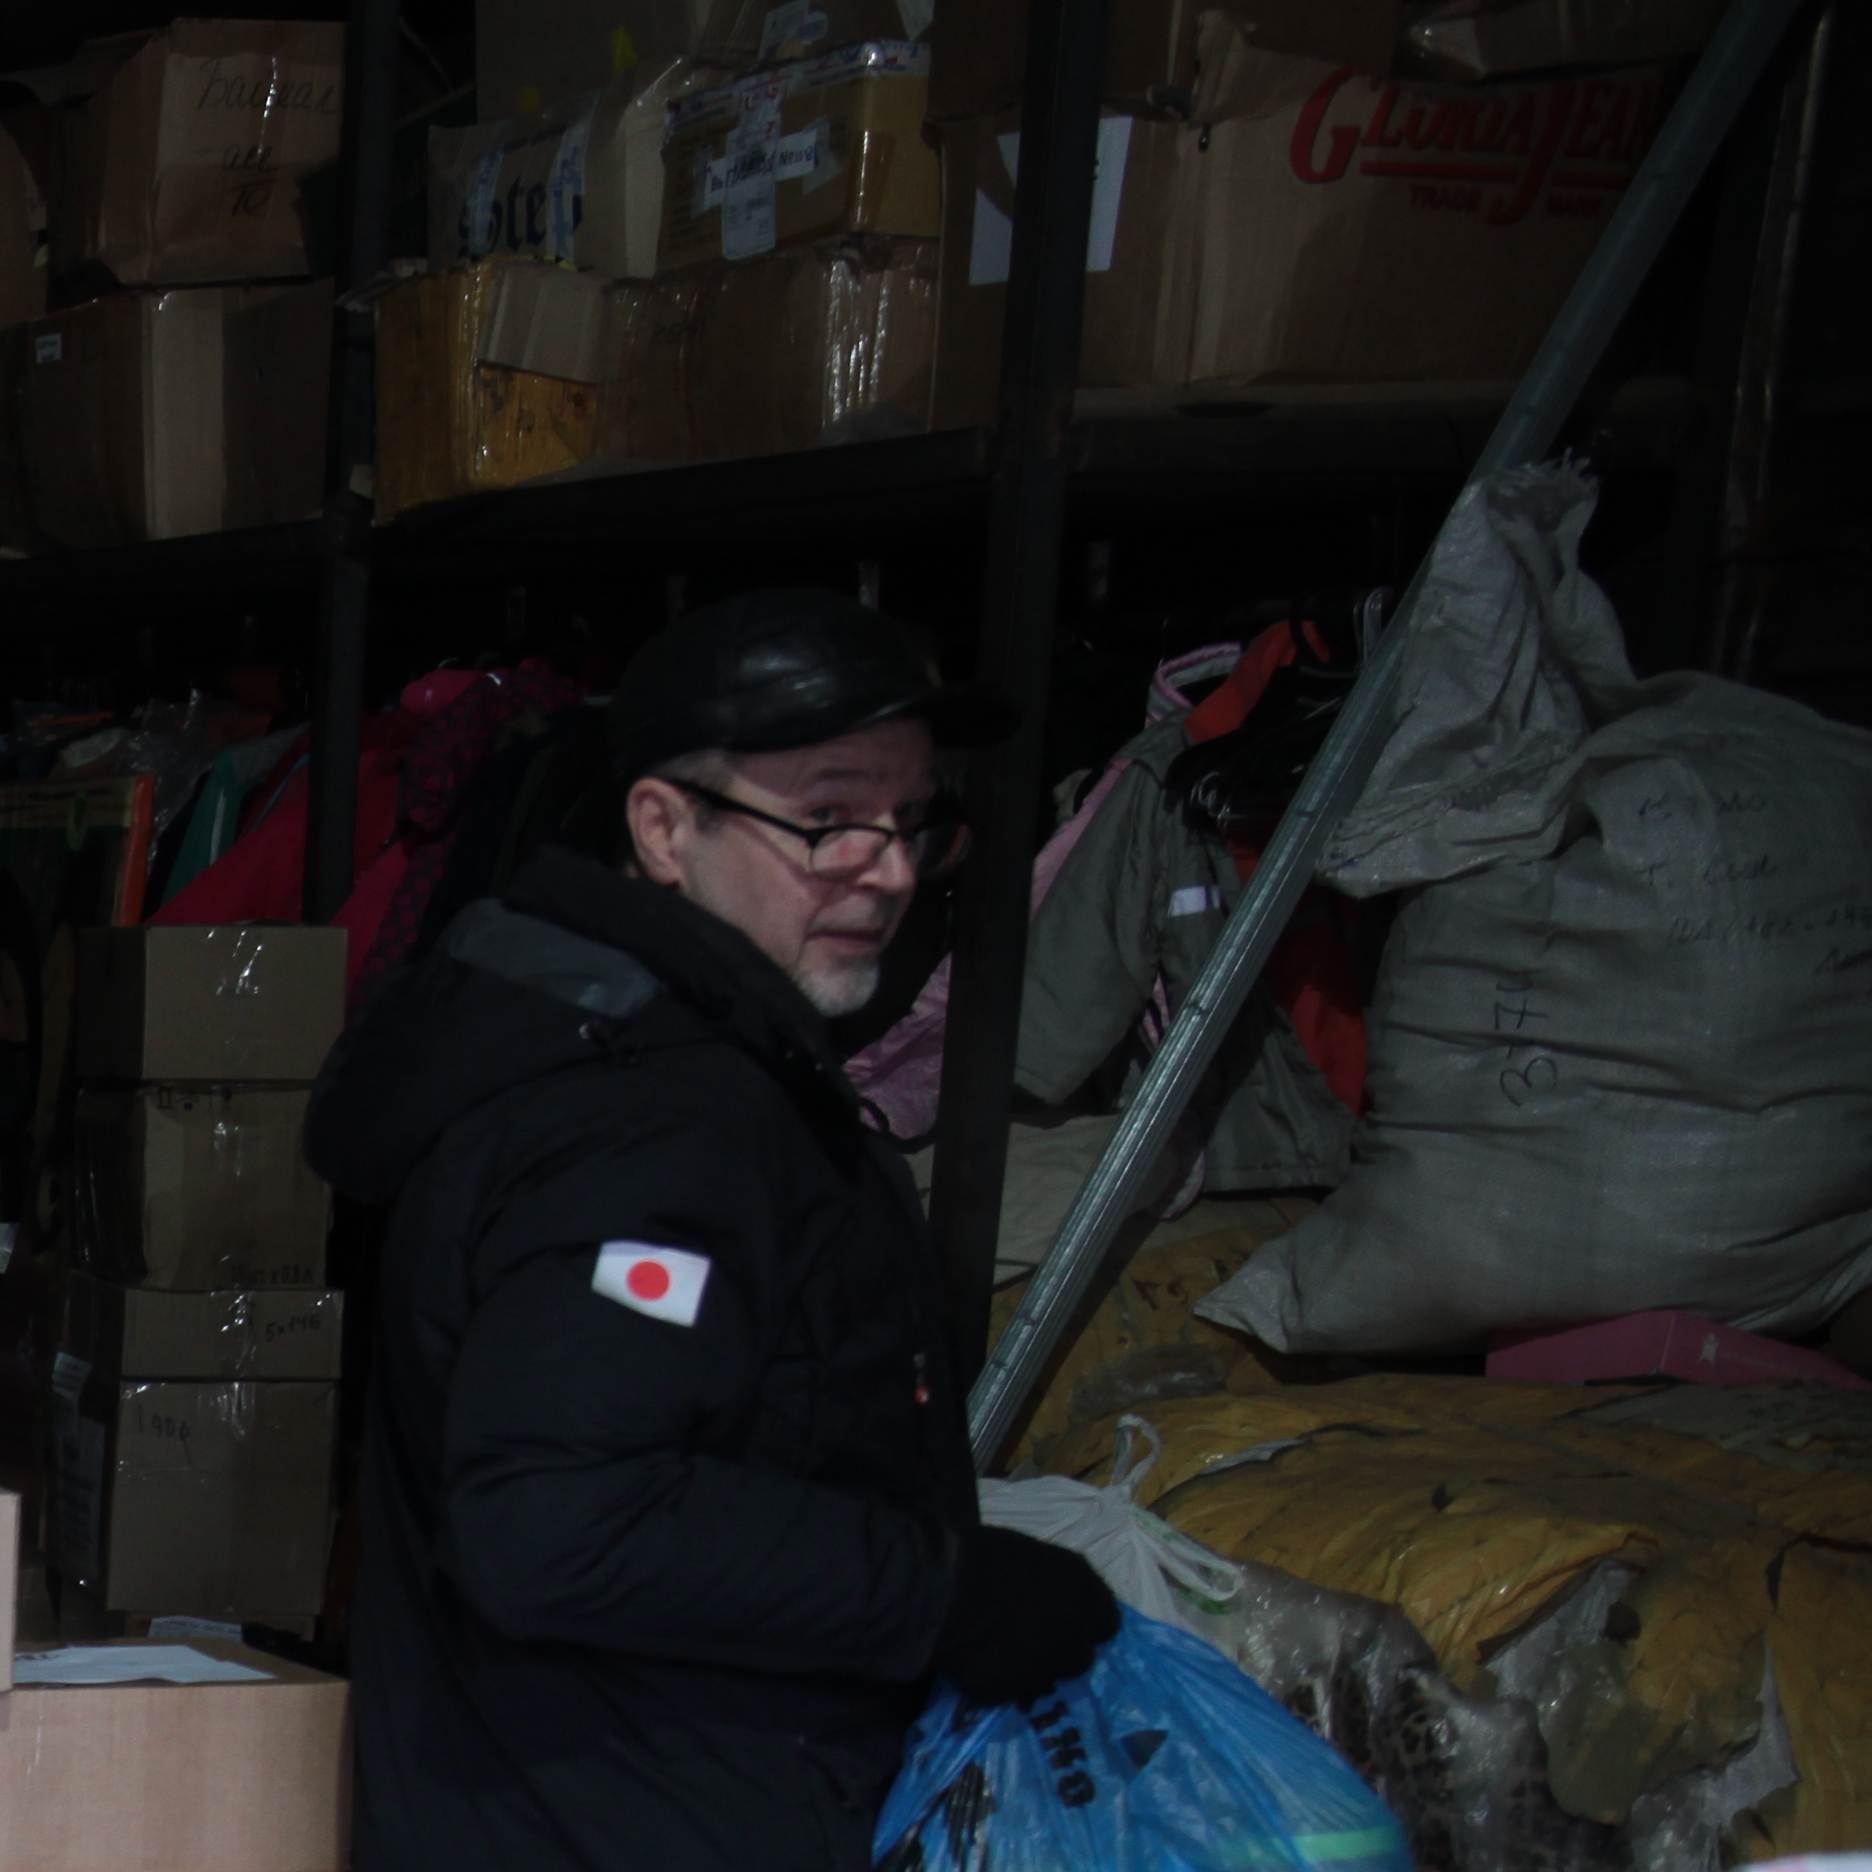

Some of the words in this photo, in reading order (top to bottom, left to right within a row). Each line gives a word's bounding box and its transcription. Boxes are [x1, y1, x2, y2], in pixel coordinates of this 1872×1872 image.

[1486, 69, 1668, 226] JEAN
[1411, 184, 1483, 211] TRADE
[1546, 193, 1602, 217] MARK
